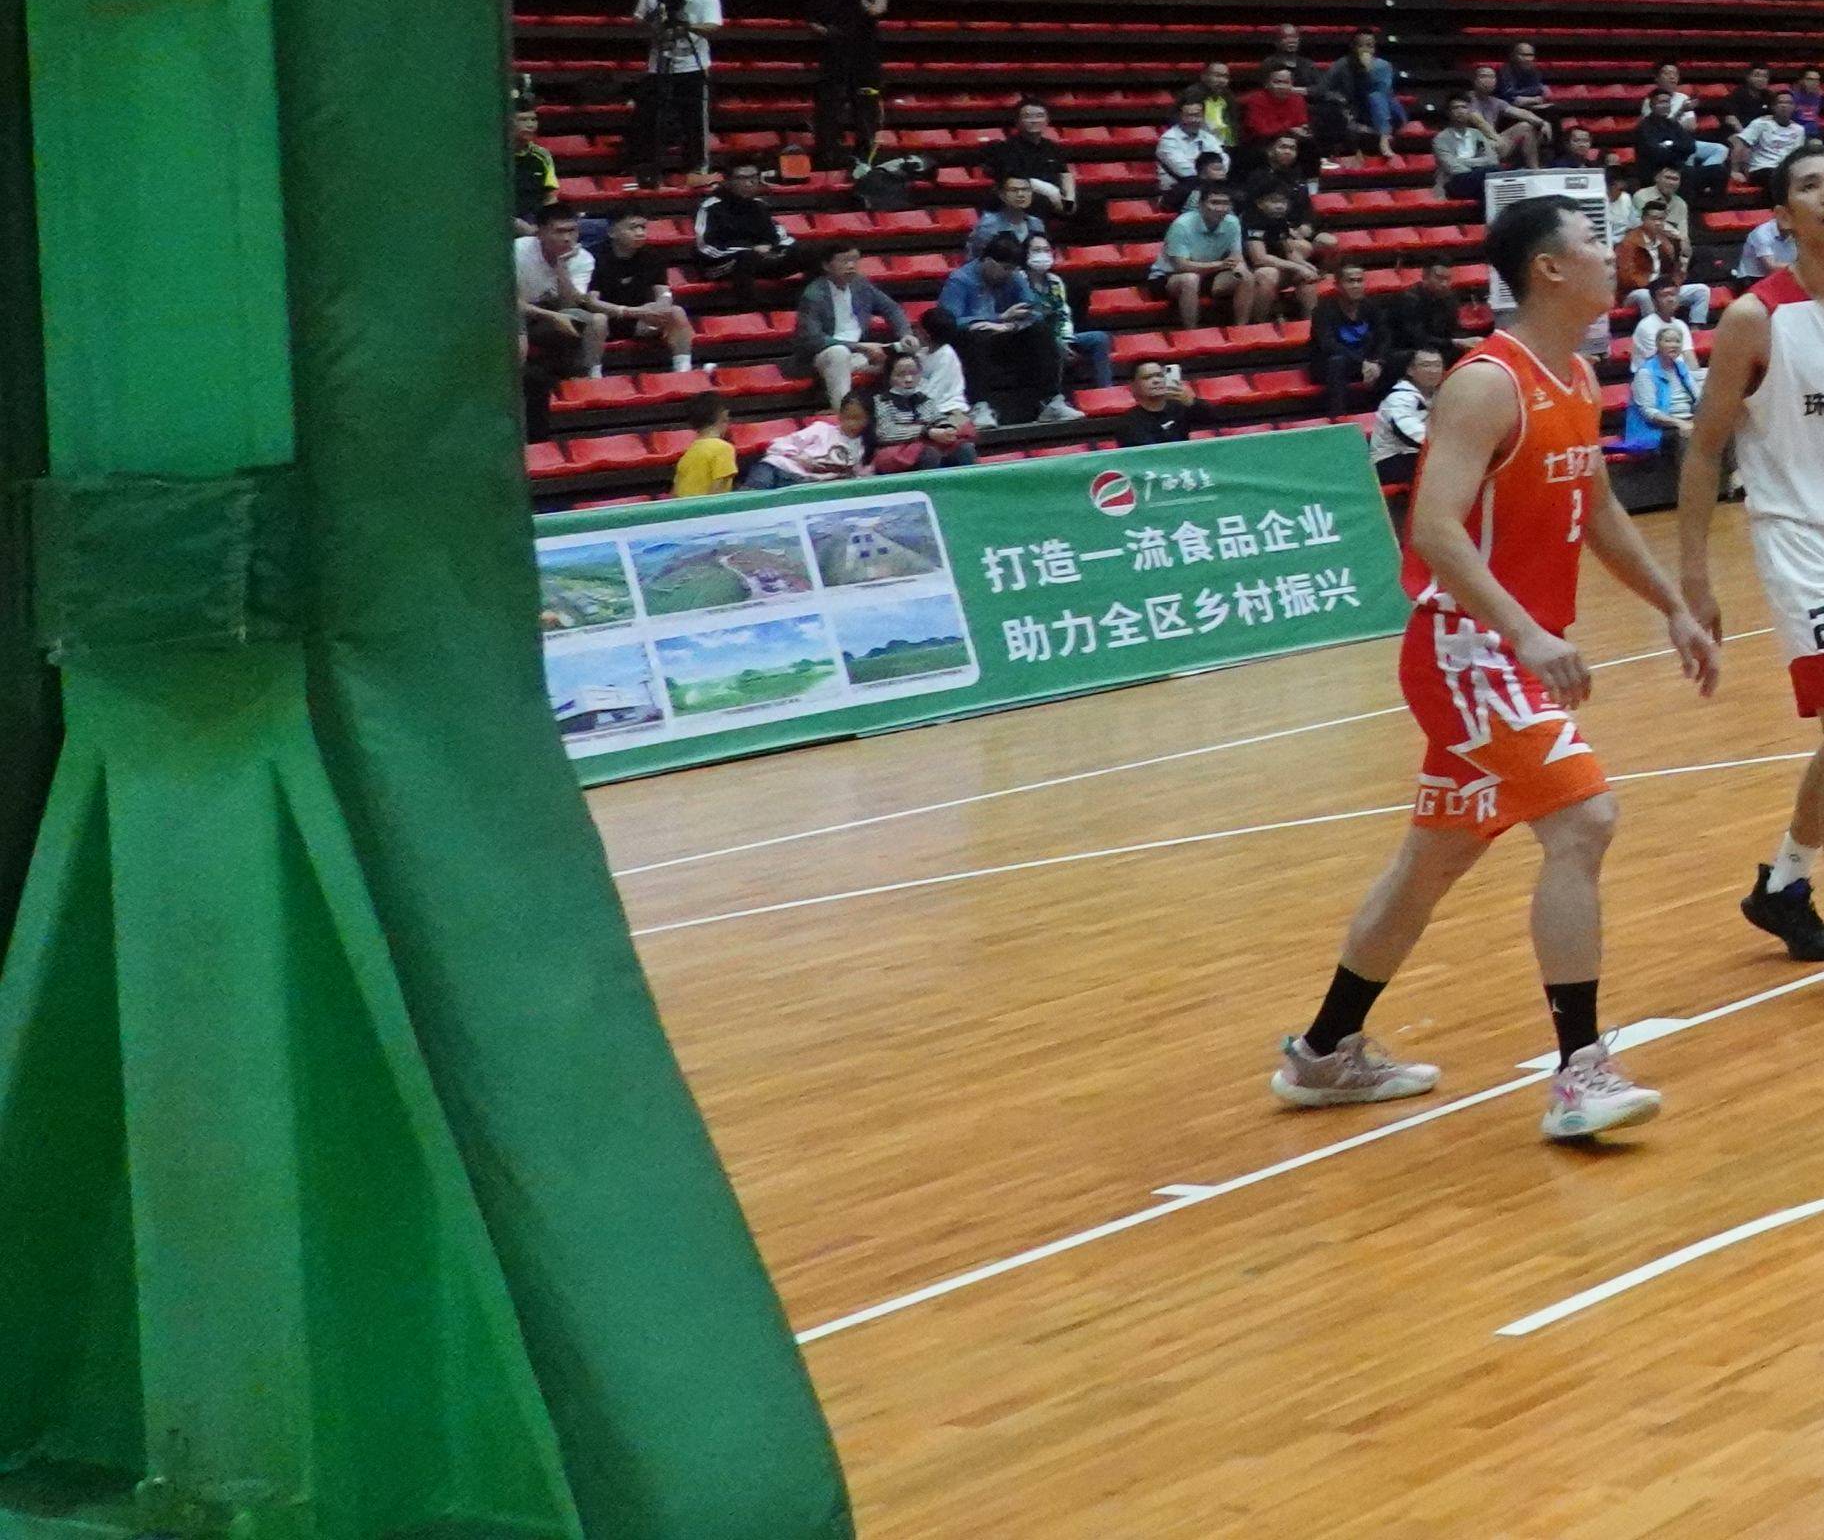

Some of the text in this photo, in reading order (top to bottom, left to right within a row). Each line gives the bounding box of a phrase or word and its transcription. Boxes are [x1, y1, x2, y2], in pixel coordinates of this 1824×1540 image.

[980, 502, 1343, 595] 打造一流食品企业
[1002, 564, 1363, 666] 助力全区乡村振兴
